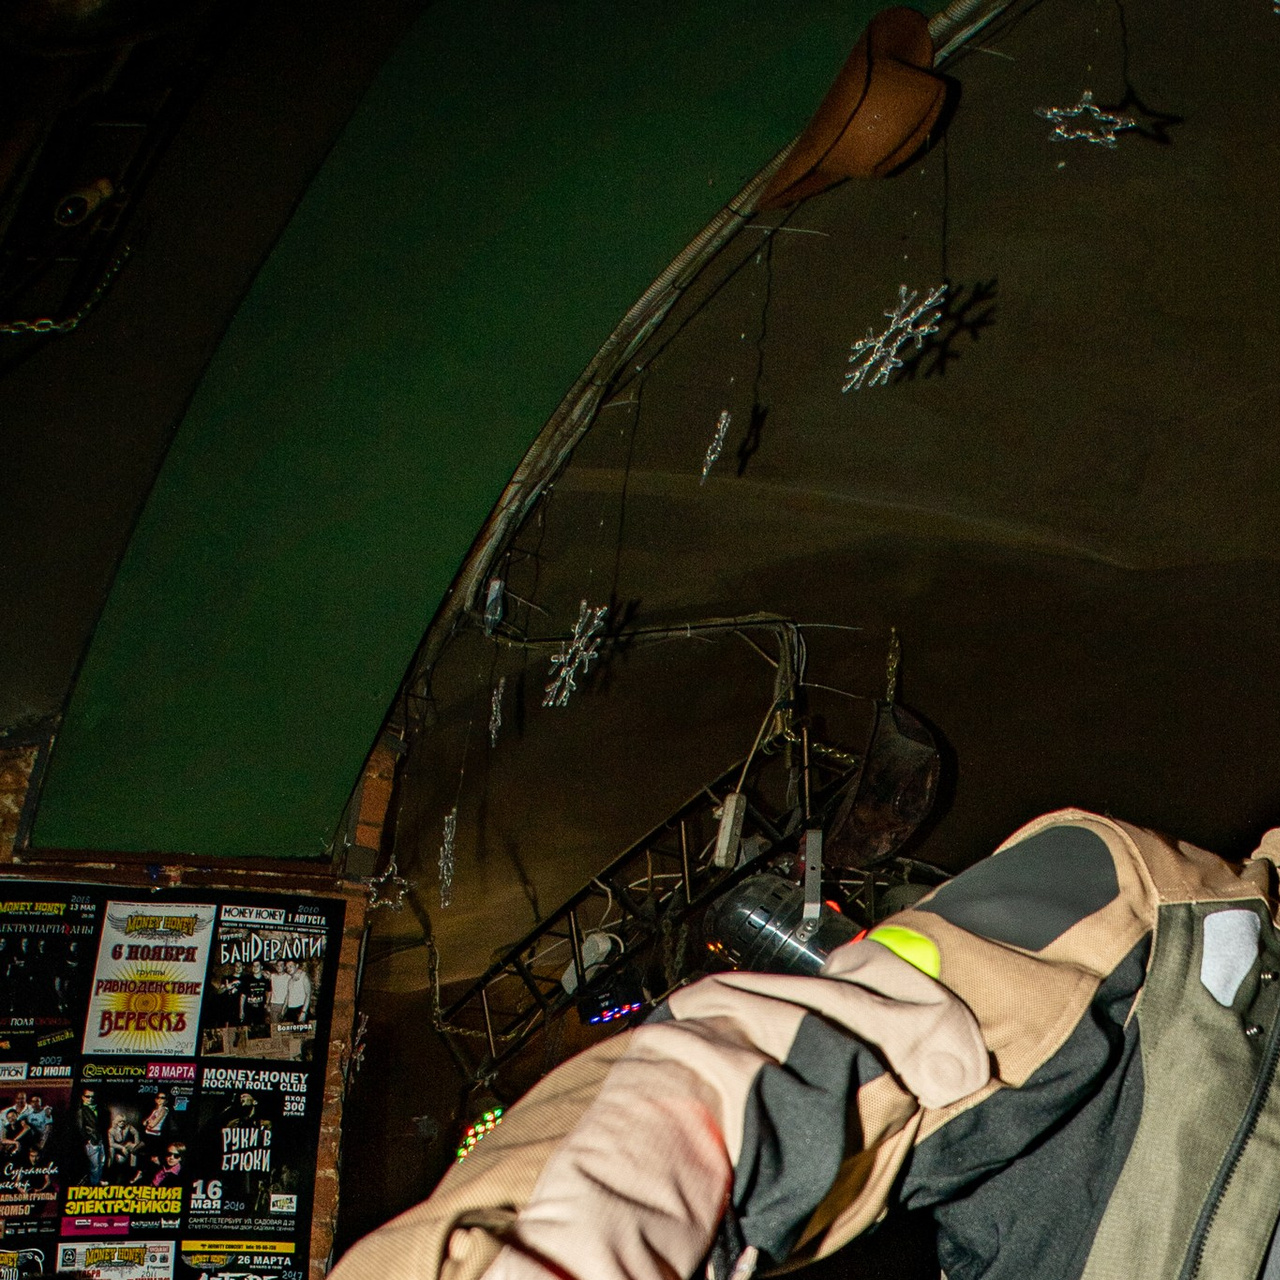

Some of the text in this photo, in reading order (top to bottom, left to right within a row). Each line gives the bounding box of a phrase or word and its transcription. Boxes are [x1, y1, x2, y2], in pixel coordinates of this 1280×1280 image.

[35, 902, 66, 916] HONEY
[223, 908, 284, 921] MONEY HONEY
[125, 915, 163, 934] MONEY
[163, 916, 197, 936] HONEY
[294, 914, 326, 926] АВГУСТА
[111, 944, 198, 962] 6 НОЯБРЯ
[95, 979, 202, 996] РАВНОДЕНСТВИЕ
[277, 1024, 313, 1033] Волгоград
[30, 1066, 72, 1077] 20 ИЮЛЯ
[83, 1063, 147, 1078] REVOLUTION
[149, 1065, 195, 1078] 28 МАРТА
[203, 1068, 309, 1084] MONEY-HONEY
[202, 1079, 273, 1091] ROCK'N'ROLL
[280, 1083, 307, 1092] CLUB
[284, 1102, 305, 1112] 300
[221, 1149, 271, 1172] БРЮКИ
[67, 1186, 182, 1200] ПРИКЛЮЧЕНИЯ
[191, 1179, 222, 1199] 16
[191, 1199, 221, 1209] мая
[188, 1217, 242, 1225] САНКТ-ПЕТЕРБУРГ
[85, 1247, 147, 1268] MONEY HONEY
[238, 1256, 292, 1266] 26 МАРТА
